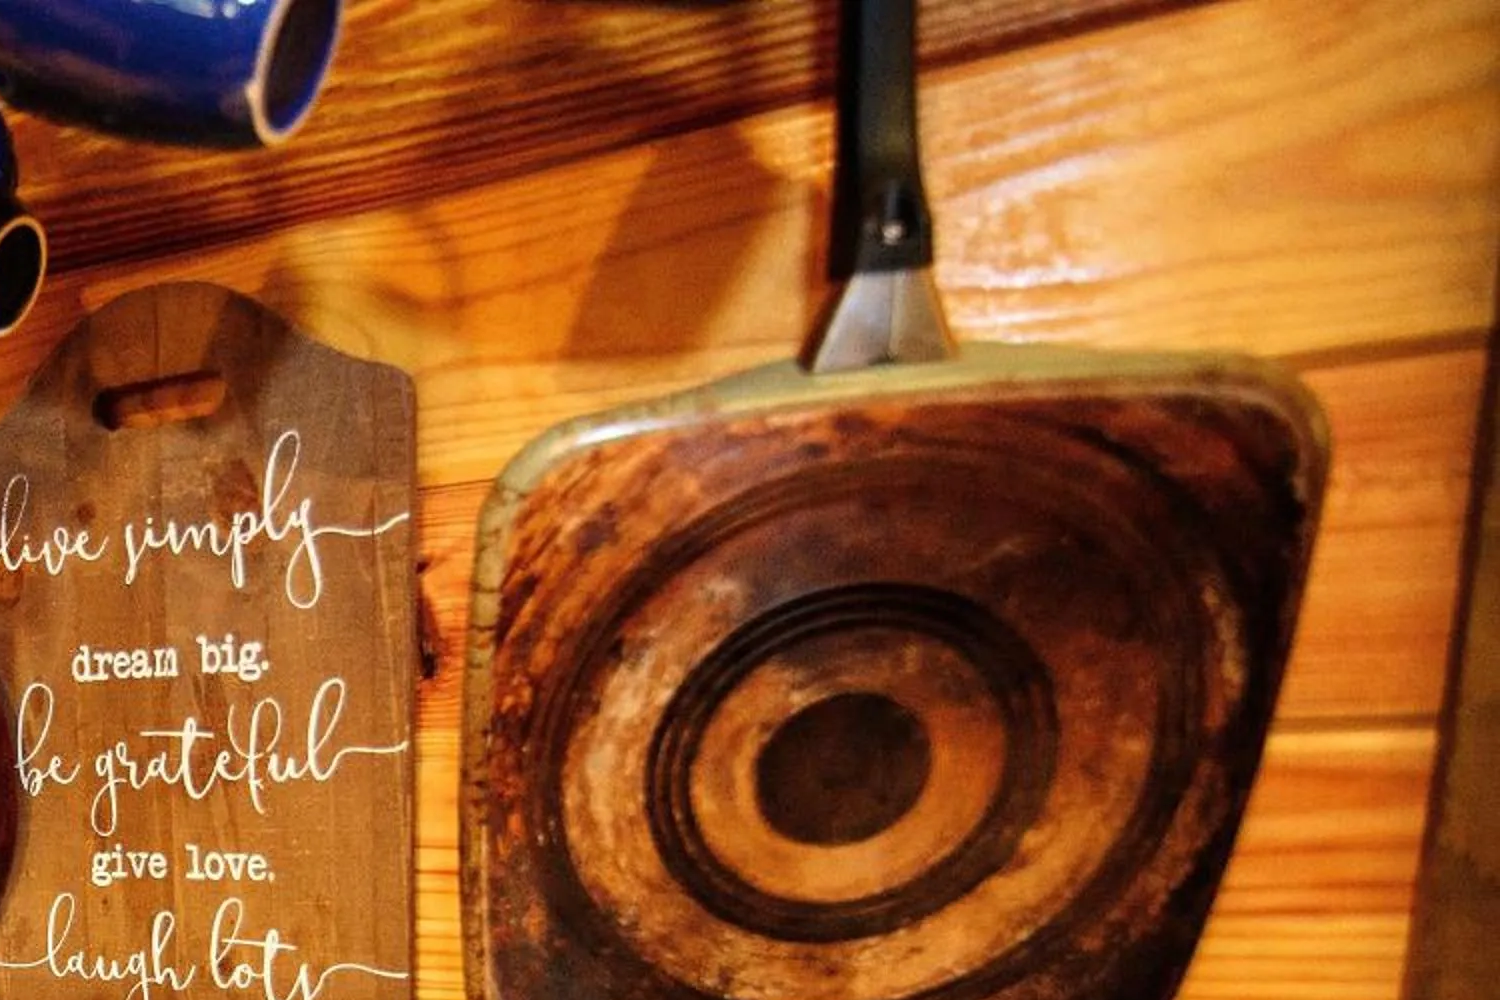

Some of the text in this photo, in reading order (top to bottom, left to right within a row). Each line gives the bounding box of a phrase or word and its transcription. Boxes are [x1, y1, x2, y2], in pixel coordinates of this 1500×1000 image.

[123, 430, 410, 609] simply
[71, 634, 270, 683] dream big.
[15, 677, 409, 836] be grateful
[91, 843, 276, 887] give love.
